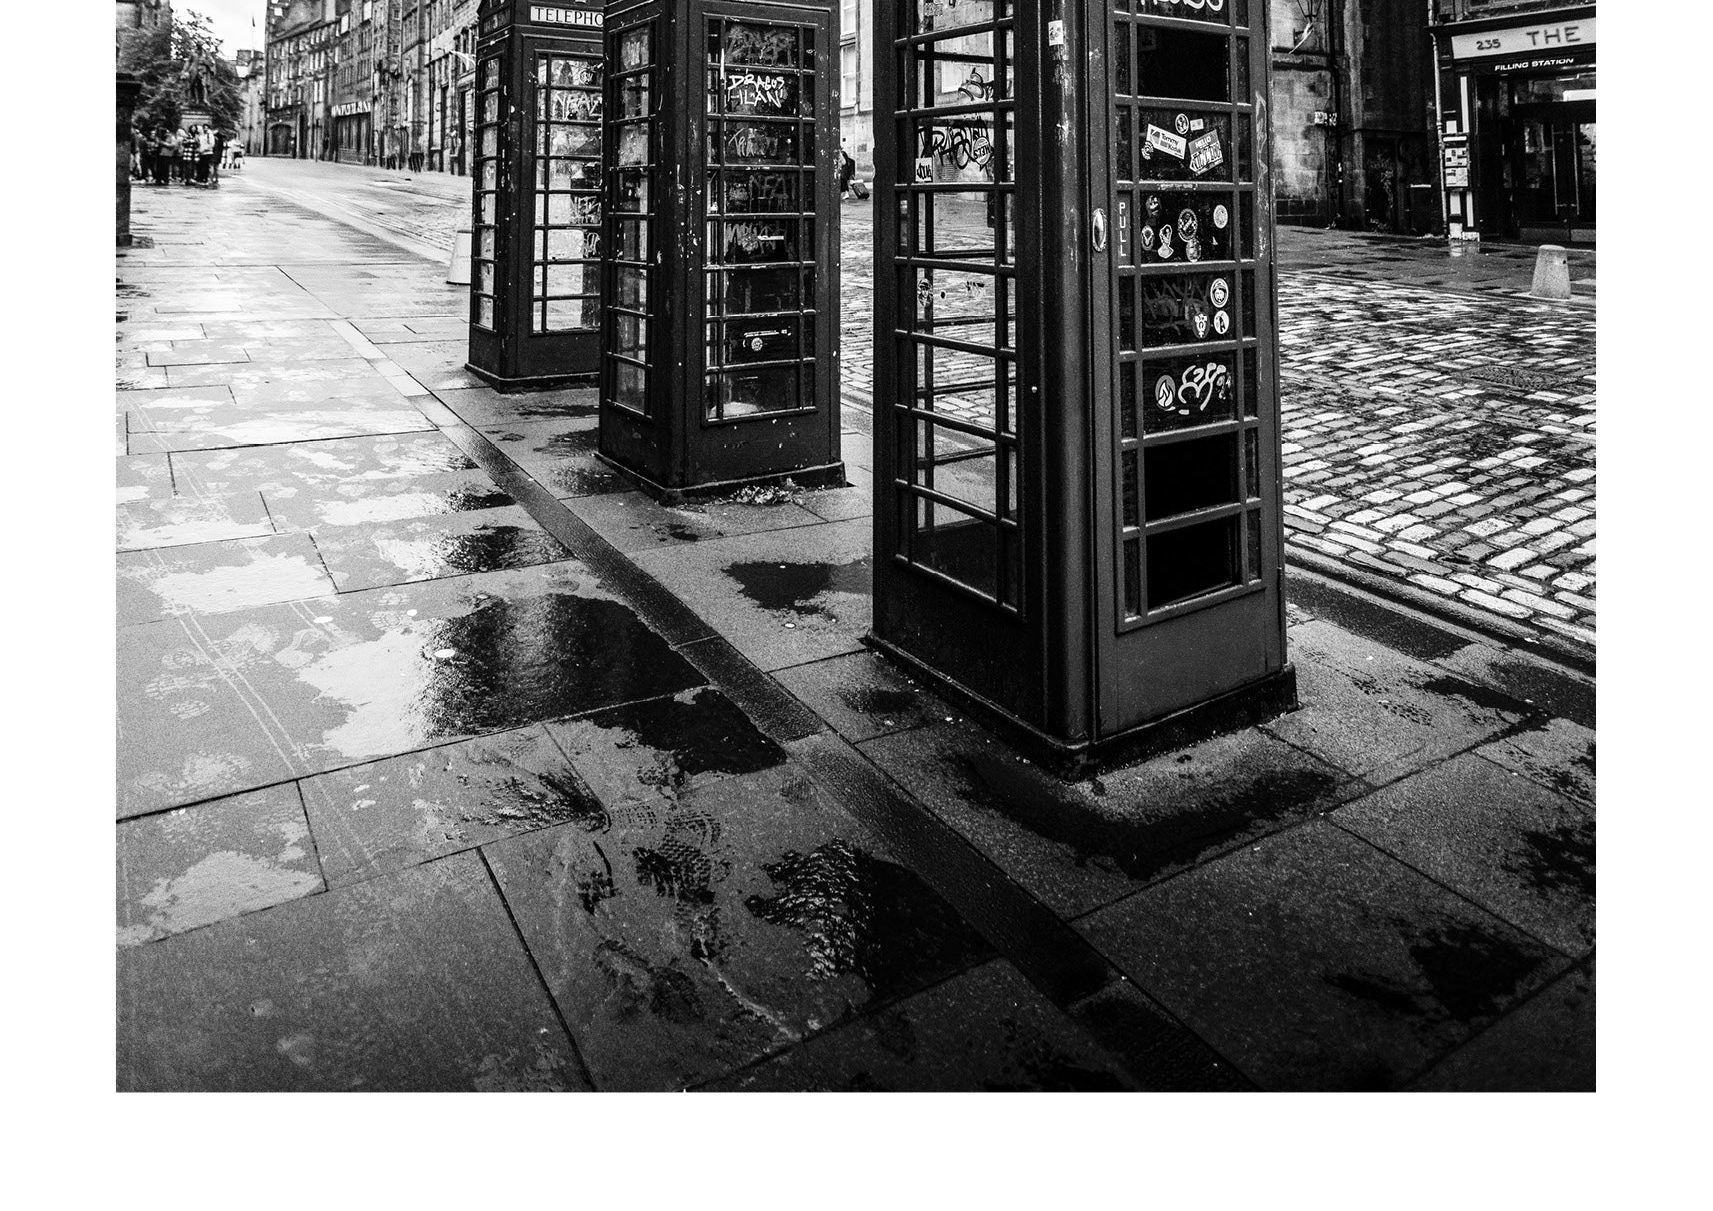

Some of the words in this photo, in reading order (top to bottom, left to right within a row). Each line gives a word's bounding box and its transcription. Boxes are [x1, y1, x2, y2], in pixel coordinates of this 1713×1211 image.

[1476, 38, 1501, 50] 235
[1525, 25, 1582, 46] THE
[1494, 61, 1529, 72] FILLING
[1531, 57, 1575, 68] STATION
[1118, 202, 1128, 257] PULL
